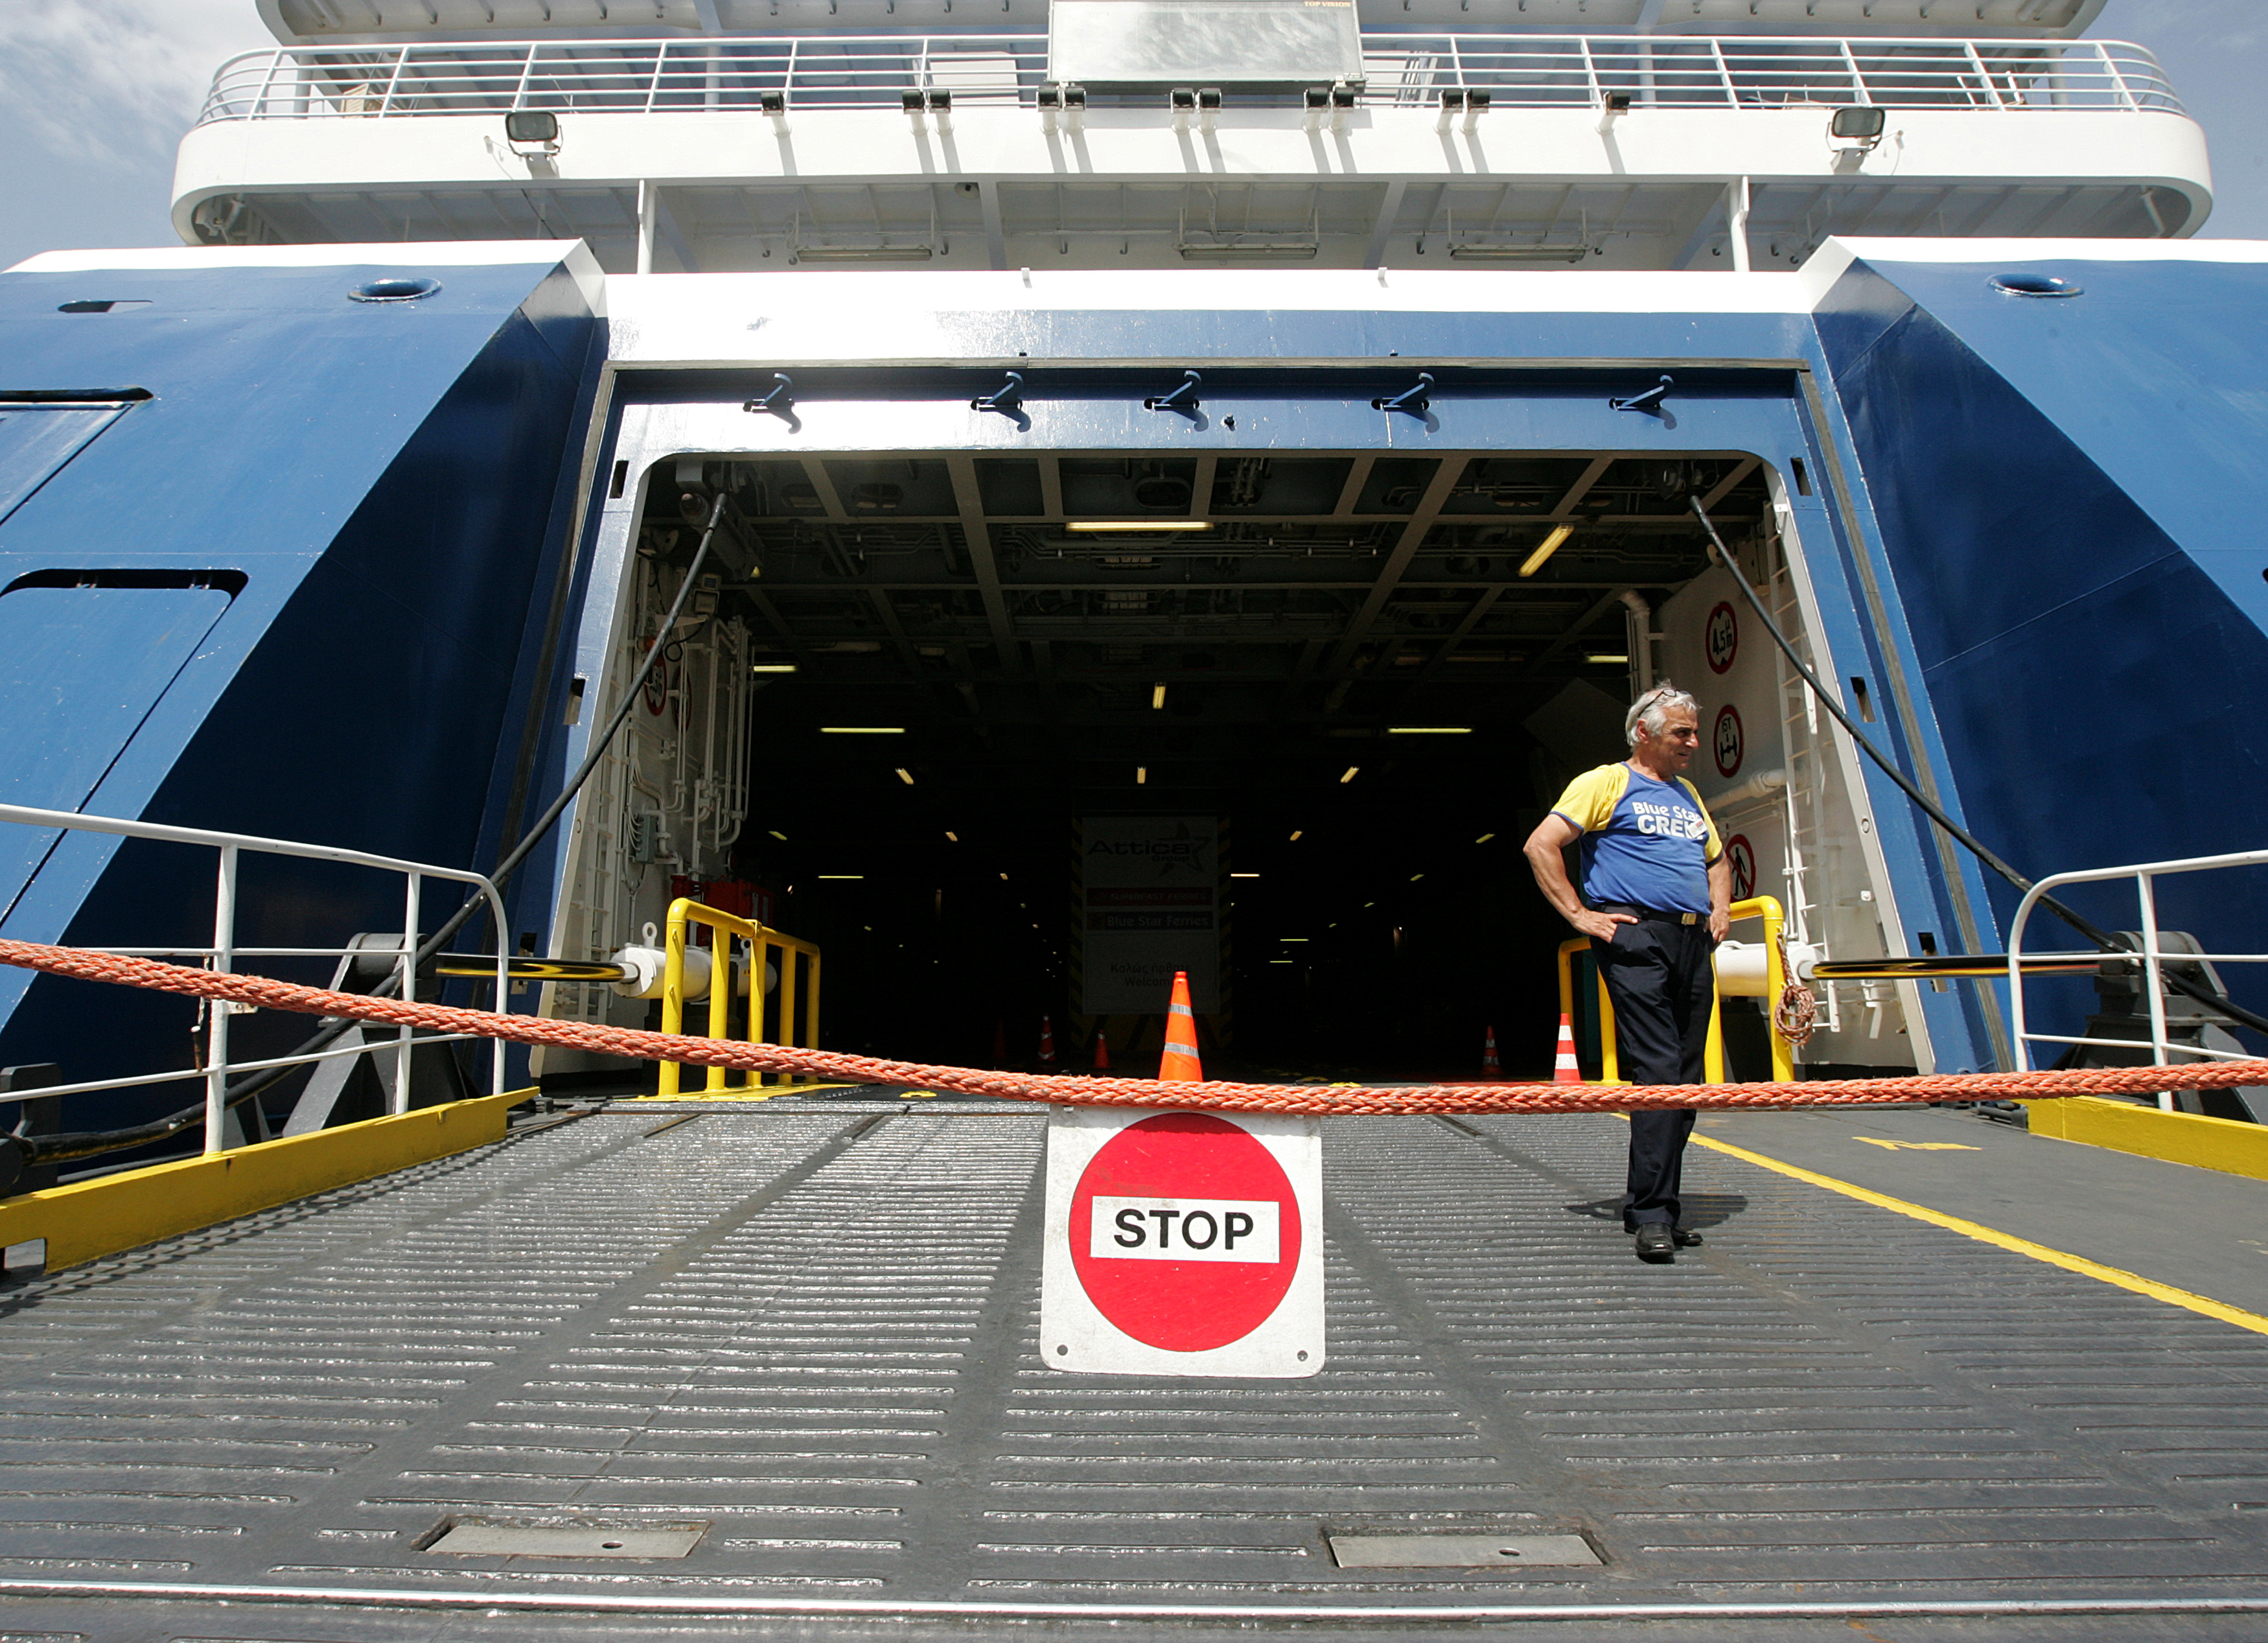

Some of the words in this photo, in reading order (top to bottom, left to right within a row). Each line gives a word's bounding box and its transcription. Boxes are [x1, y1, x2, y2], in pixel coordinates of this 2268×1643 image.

[1632, 801, 1671, 817] Blue
[1087, 840, 1190, 855] Attica
[1109, 892, 1164, 901] SUPERFAST
[1168, 892, 1208, 901] FERRIES
[1107, 916, 1135, 927] Blue
[1138, 916, 1163, 926] Star
[1166, 916, 1209, 926] Ferries
[1125, 976, 1173, 987] Welcom
[1113, 1208, 1255, 1250] STOP
